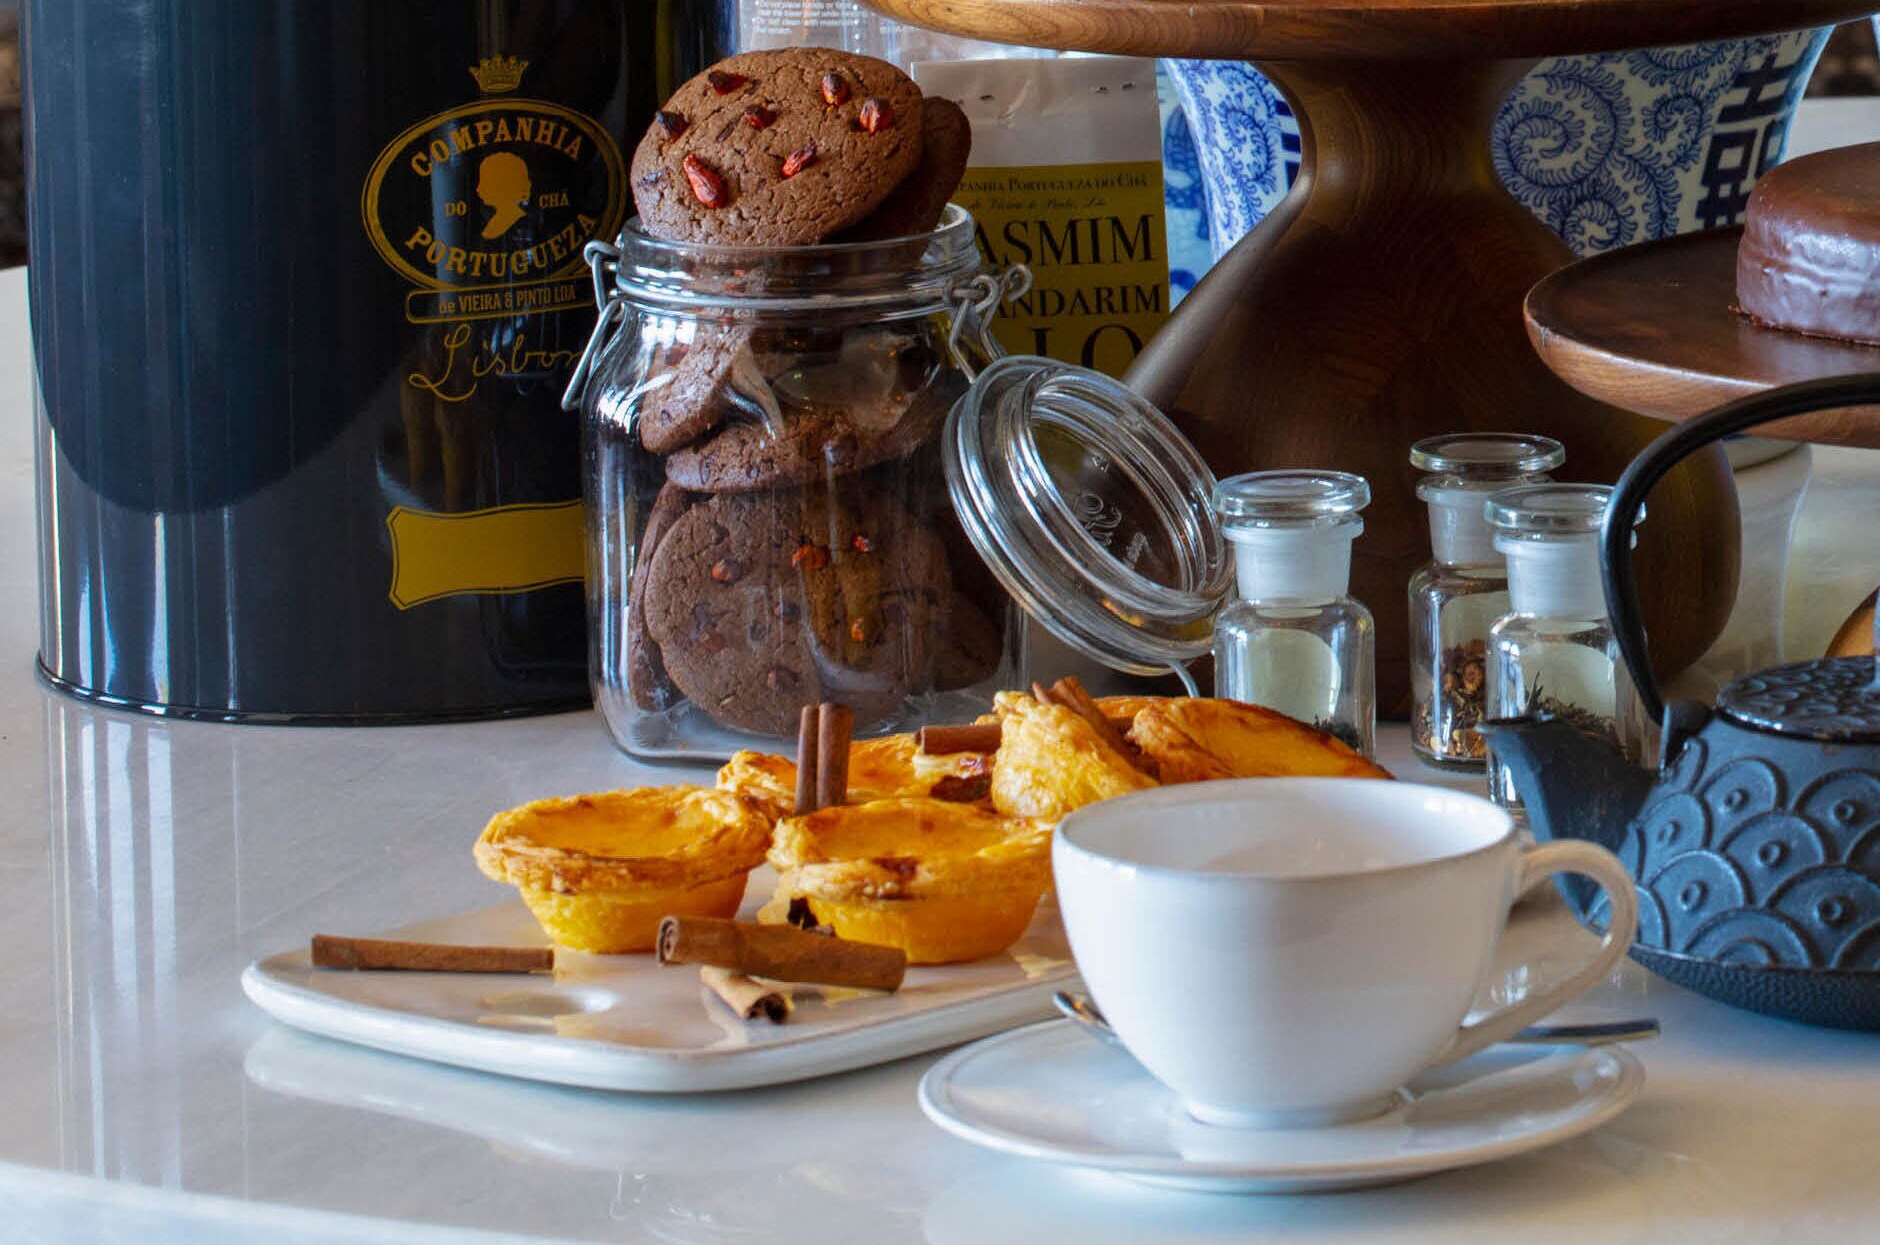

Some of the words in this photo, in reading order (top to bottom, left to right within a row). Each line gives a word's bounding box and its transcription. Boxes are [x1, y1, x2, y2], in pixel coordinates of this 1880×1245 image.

[410, 116, 583, 177] COMPANHIA
[446, 200, 467, 218] DO
[405, 212, 597, 278] PORTUGUEZA
[974, 213, 1155, 266] ASMIM
[458, 292, 501, 313] VIEIRA
[516, 287, 551, 306] PINTO
